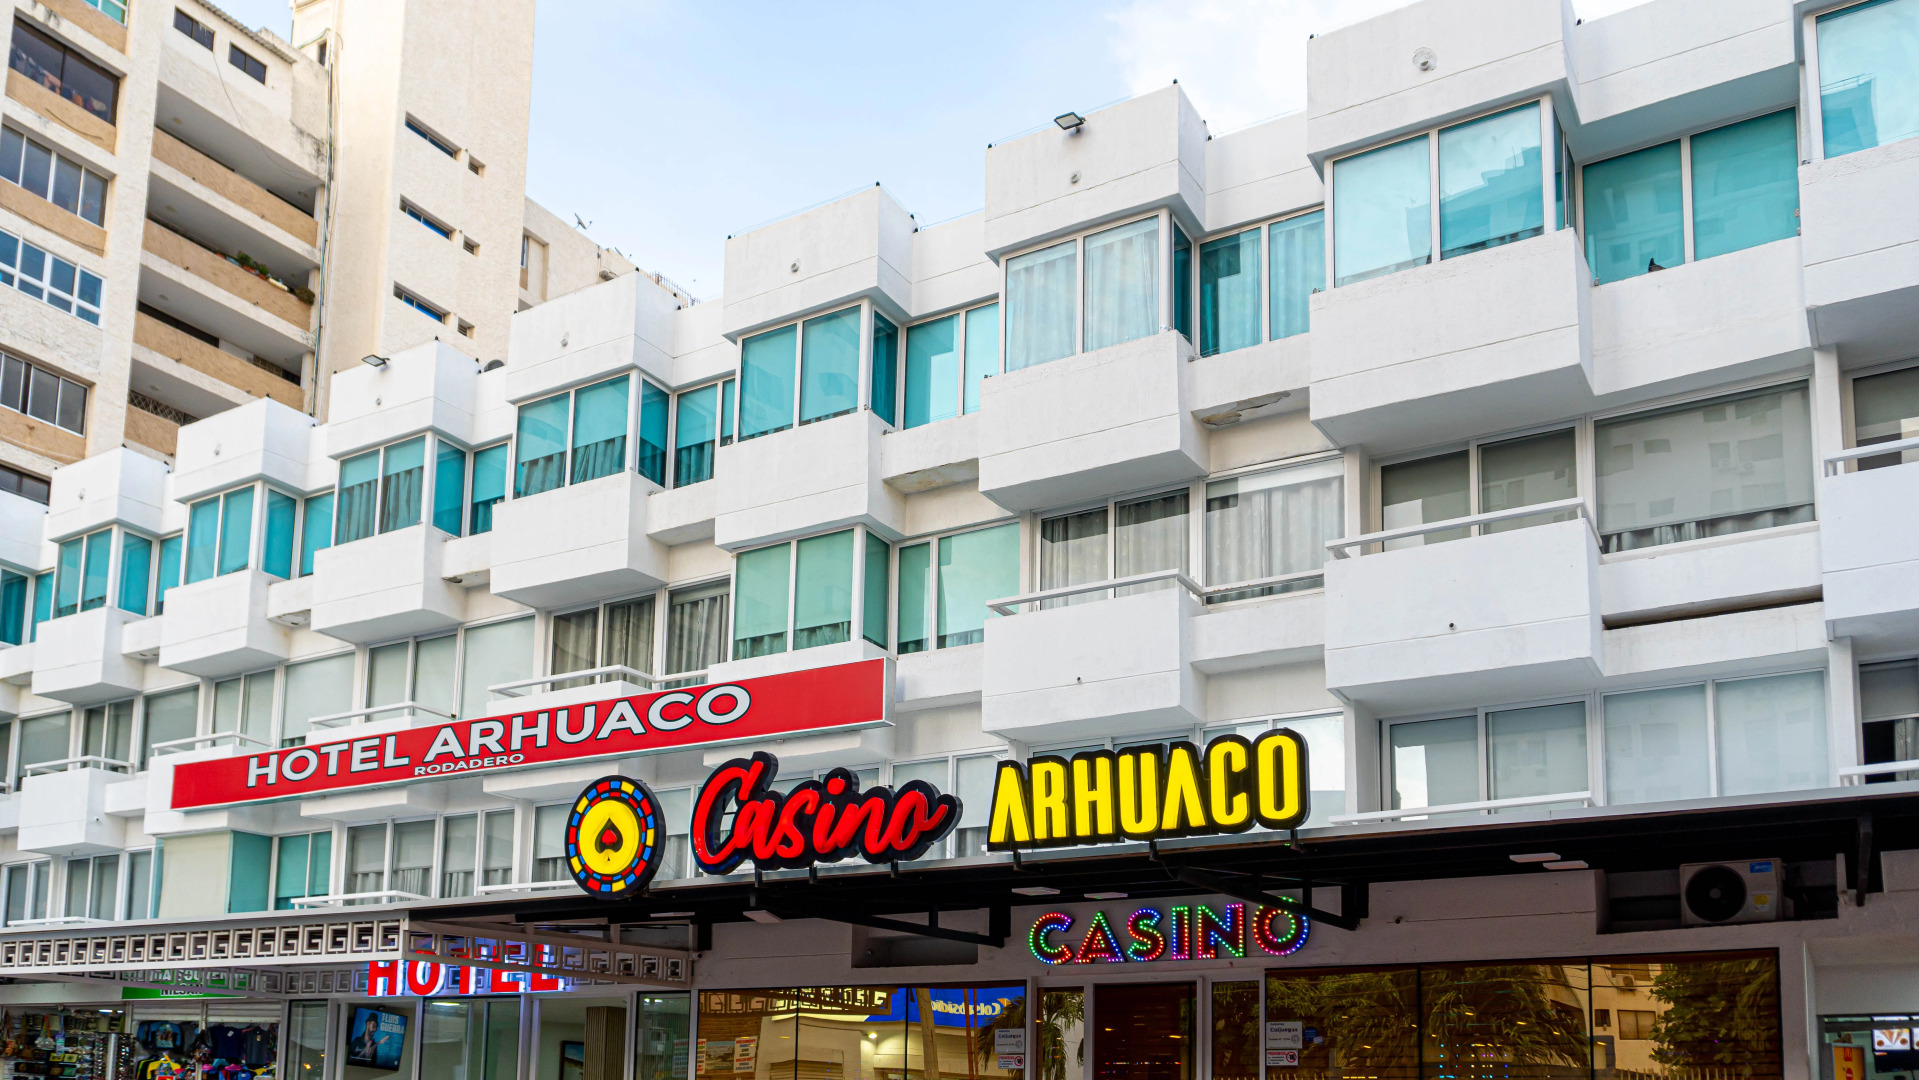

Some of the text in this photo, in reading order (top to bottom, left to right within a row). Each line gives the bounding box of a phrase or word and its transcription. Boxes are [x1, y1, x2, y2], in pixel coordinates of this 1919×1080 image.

[247, 684, 752, 787] HOTEL ARHUACO
[413, 753, 525, 776] RODADERO
[693, 734, 1300, 868] Casino ARHUACO
[1027, 895, 1311, 966] CASINO
[367, 943, 562, 997] HOTEL
